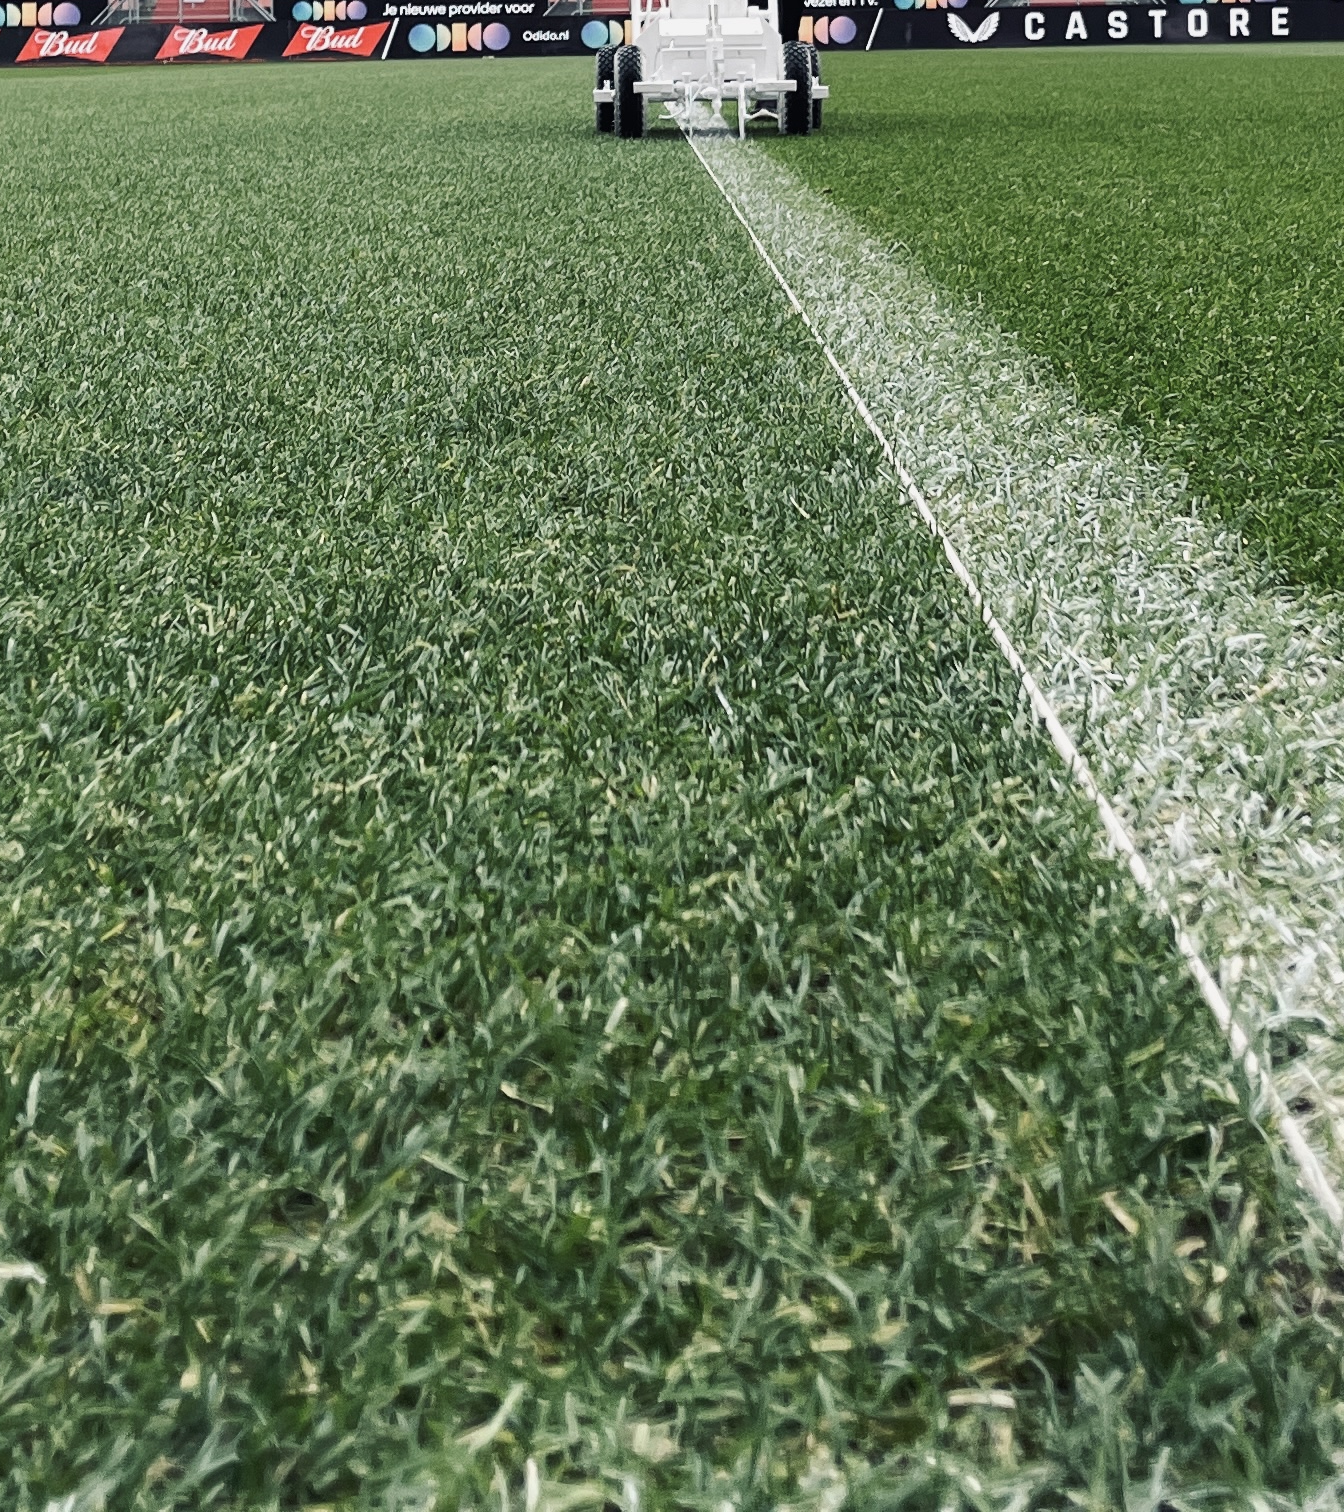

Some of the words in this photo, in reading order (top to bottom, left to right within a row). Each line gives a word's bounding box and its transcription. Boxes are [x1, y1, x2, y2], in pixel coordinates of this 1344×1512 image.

[382, 3, 398, 17] Je
[399, 3, 446, 17] nieuwe
[448, 1, 503, 19] provider
[505, 2, 535, 15] voor
[1024, 6, 1290, 41] CASTORE
[34, 29, 98, 57] Bud
[173, 27, 236, 55] Bud
[301, 24, 364, 52] Bud
[522, 28, 570, 42] Odido.nl
